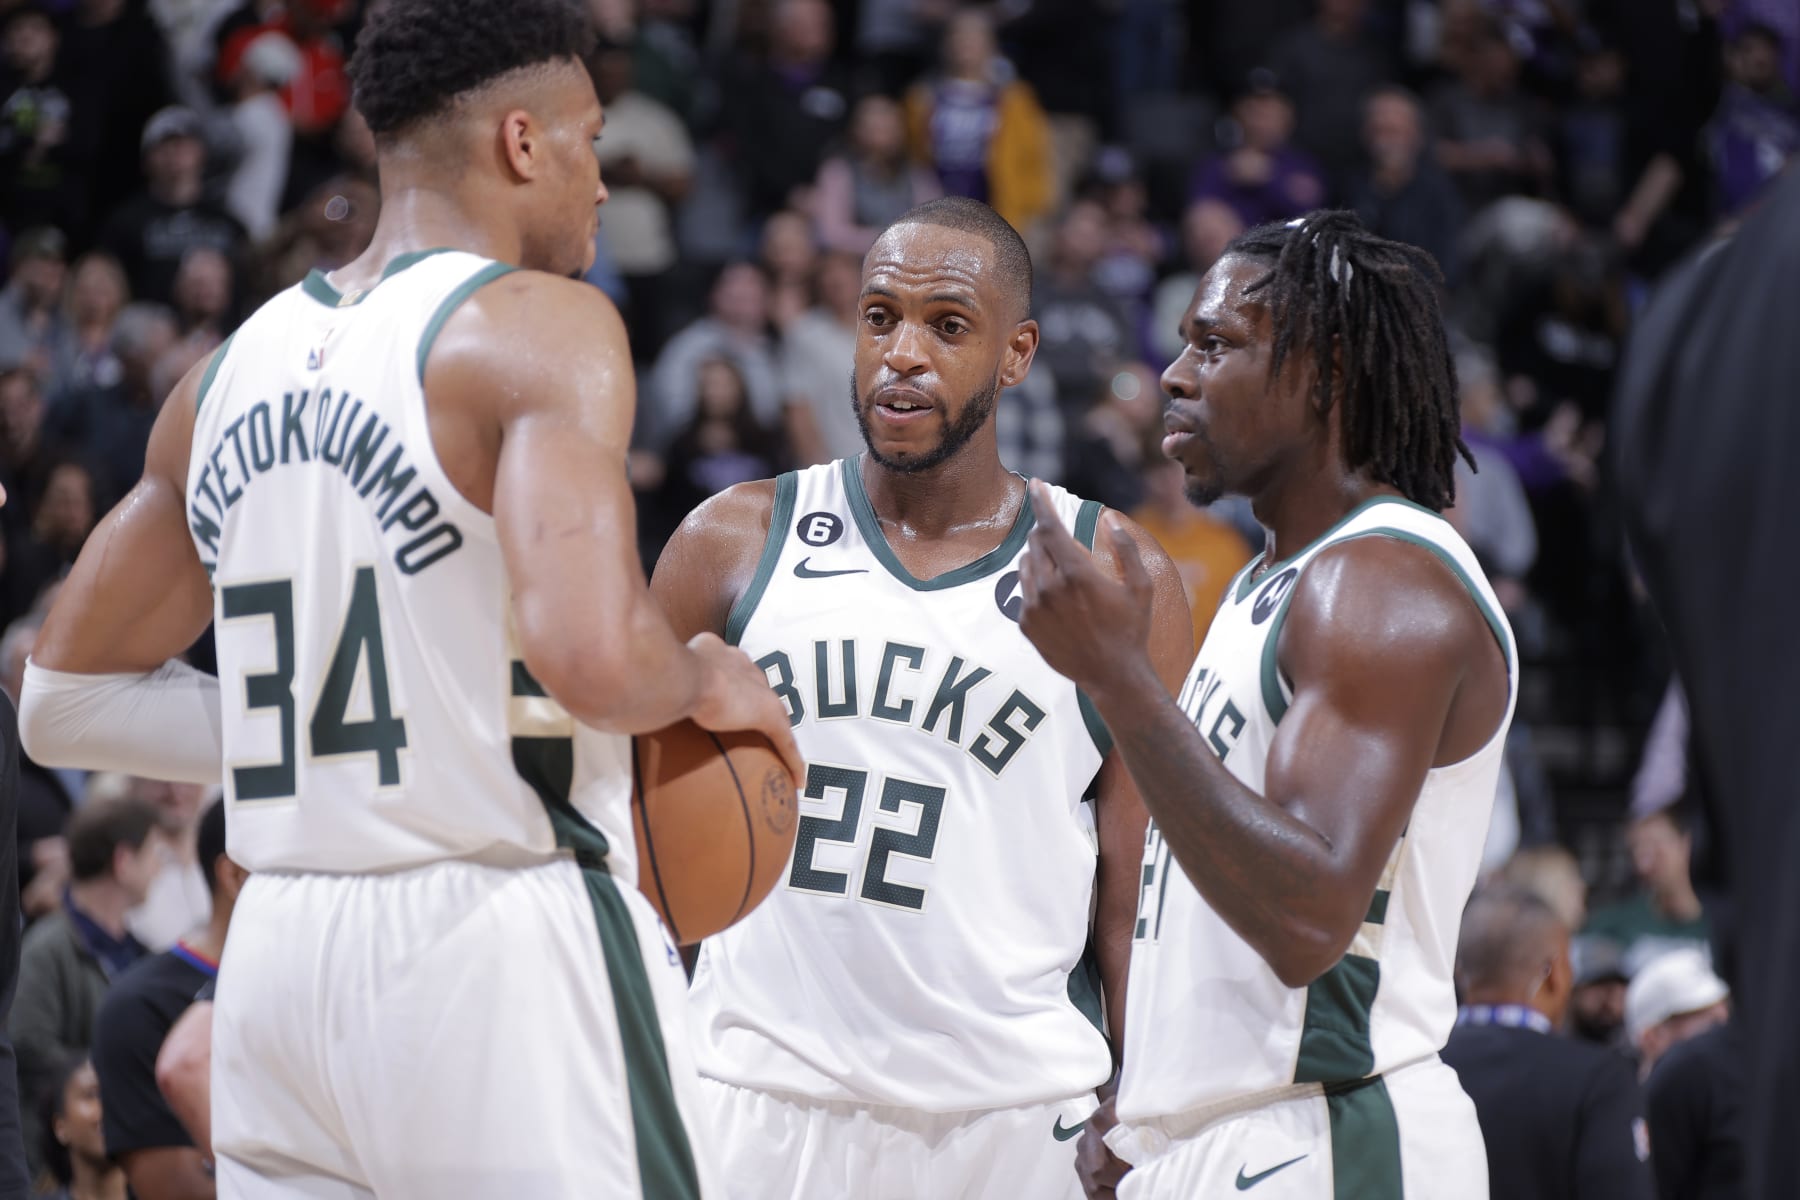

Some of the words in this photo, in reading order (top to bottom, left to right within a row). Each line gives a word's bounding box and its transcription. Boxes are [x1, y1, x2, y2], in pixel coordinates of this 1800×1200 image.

[190, 386, 464, 592] NTETOKOUNMPO
[806, 515, 834, 543] 6
[221, 564, 409, 802] 34
[752, 637, 1049, 779] BUCKS
[786, 761, 949, 913] 22
